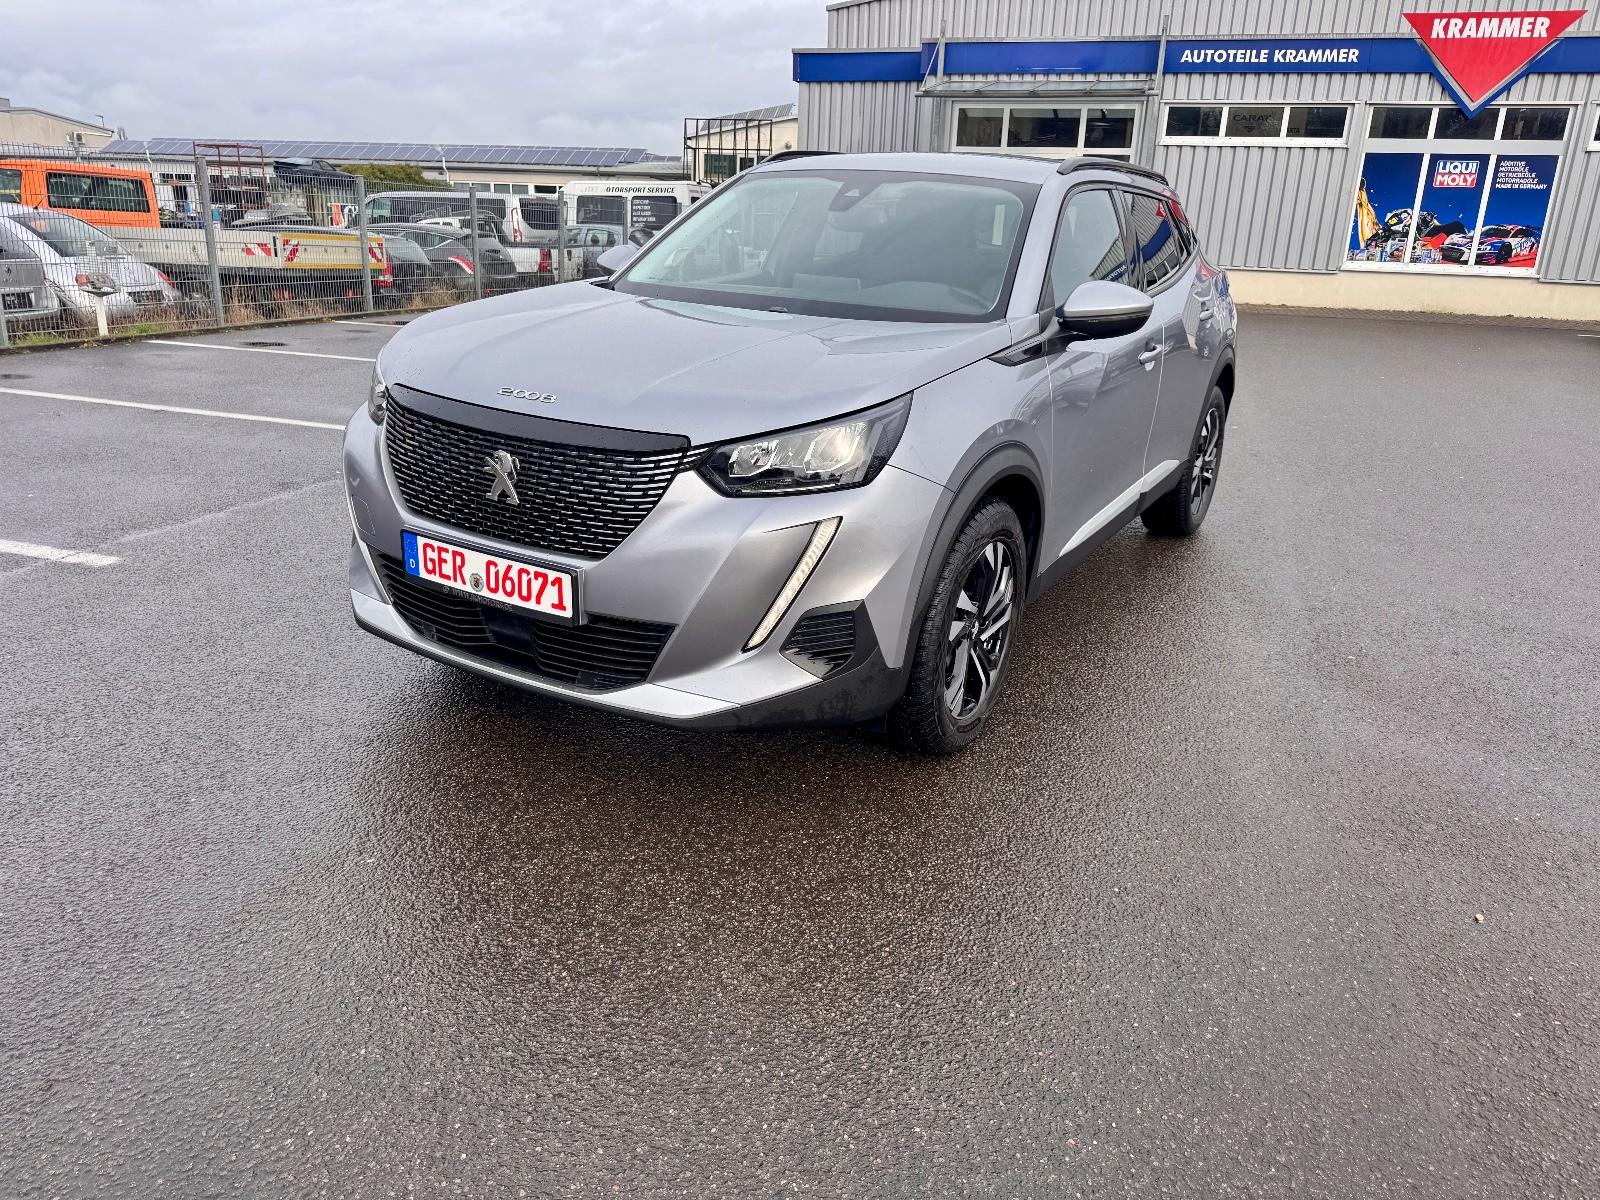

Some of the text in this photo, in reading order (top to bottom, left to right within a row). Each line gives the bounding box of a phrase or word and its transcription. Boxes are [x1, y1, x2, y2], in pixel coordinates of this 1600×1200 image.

[1430, 17, 1551, 39] KRAMMER
[1180, 48, 1360, 63] AUTOTEILE KRAMMER
[1438, 161, 1477, 174] LIQUI
[1435, 174, 1476, 185] MOLY
[604, 186, 646, 194] OTORSPORT
[496, 386, 557, 403] 2008
[410, 542, 567, 612] D GER 06071
